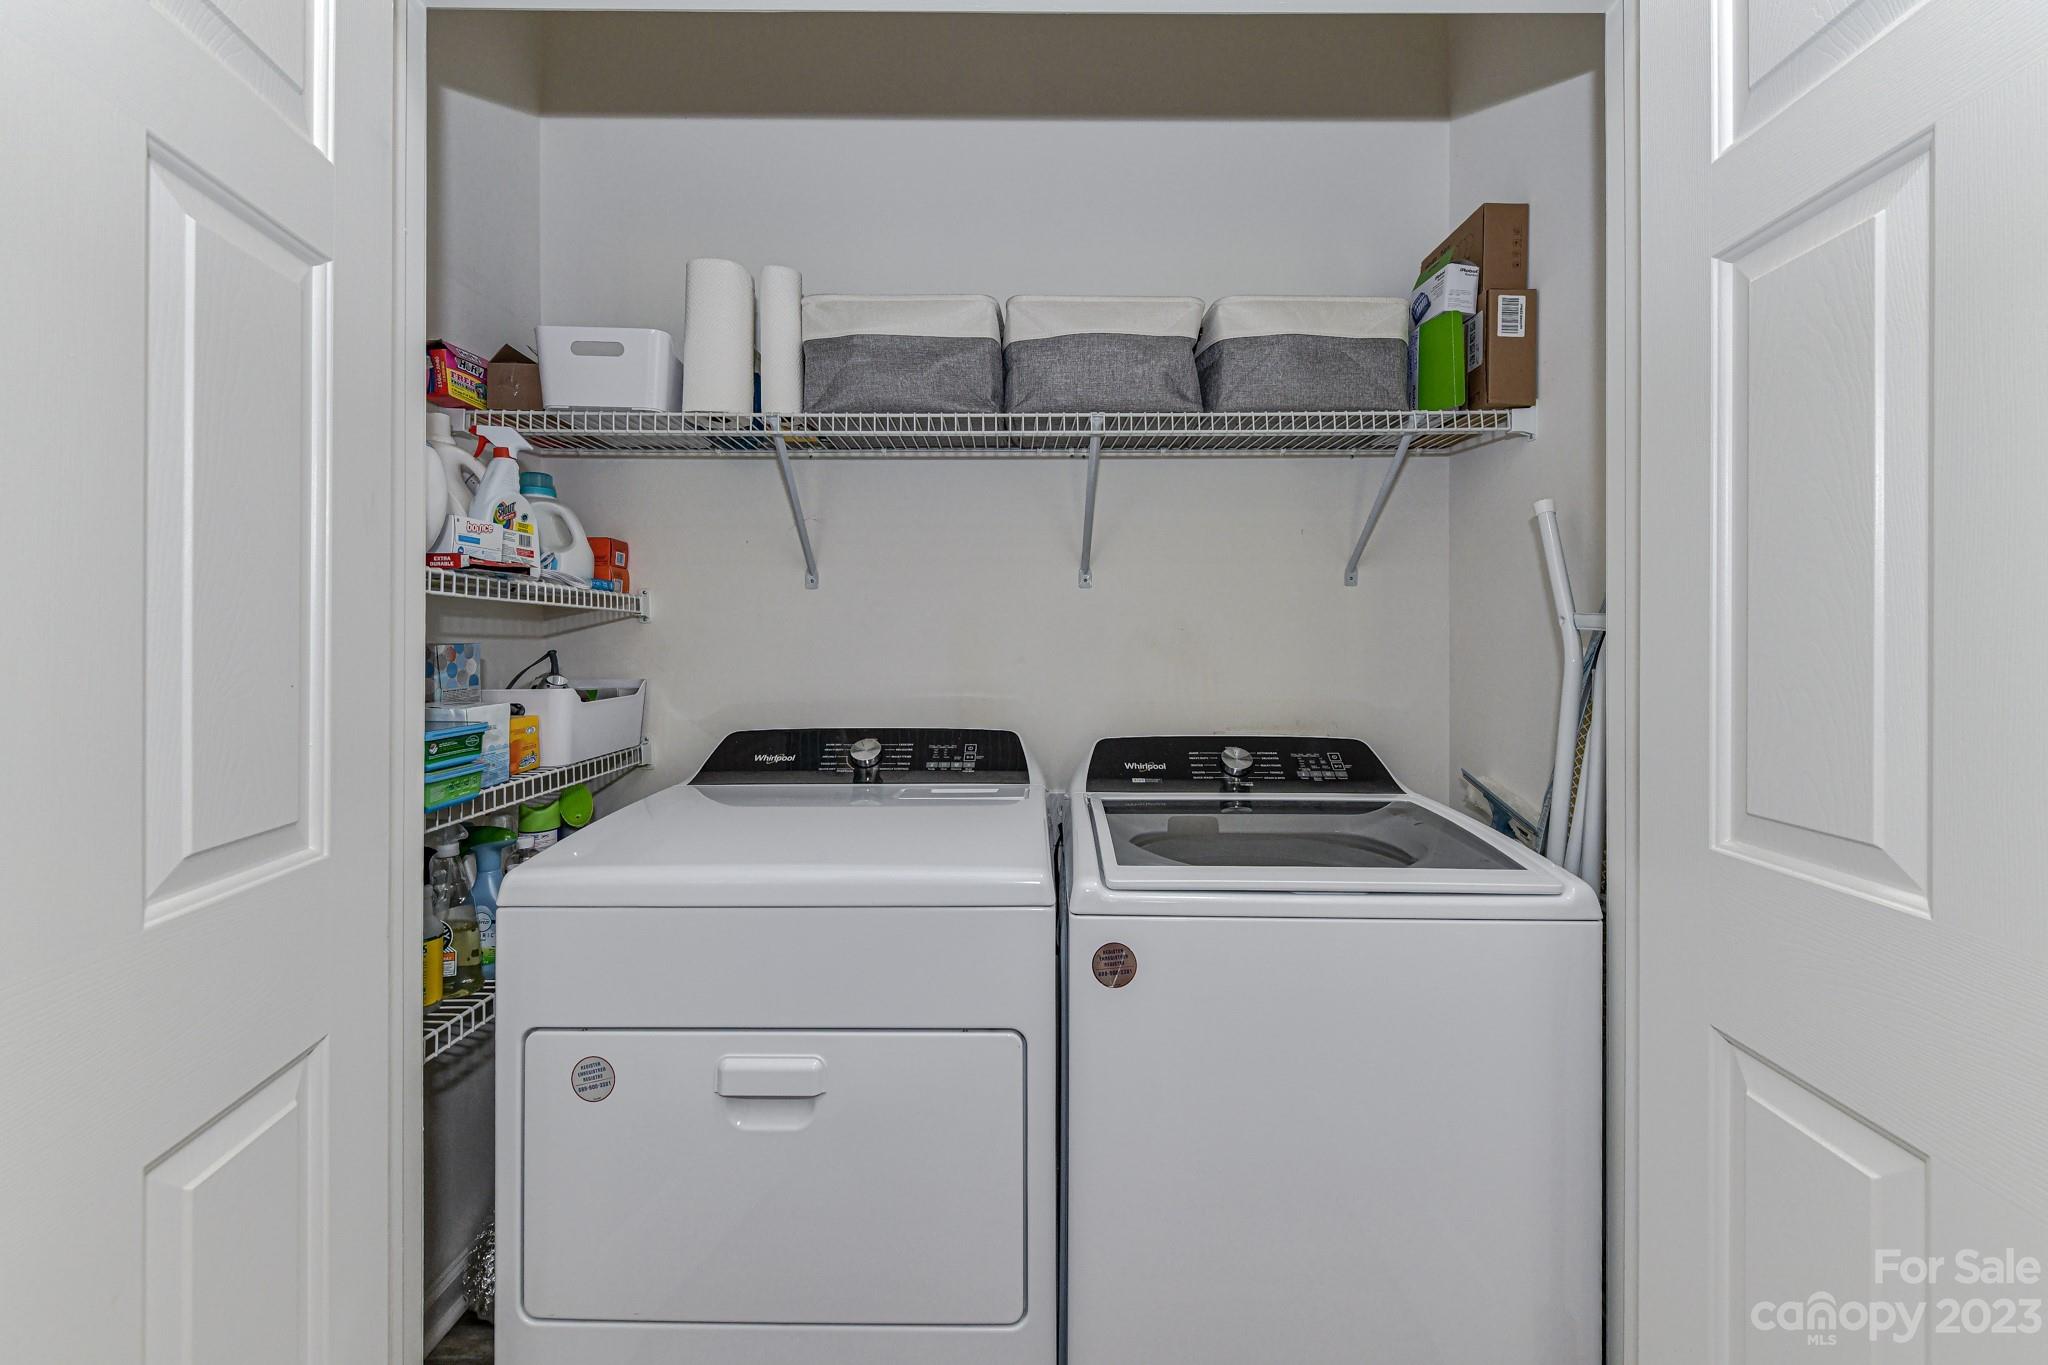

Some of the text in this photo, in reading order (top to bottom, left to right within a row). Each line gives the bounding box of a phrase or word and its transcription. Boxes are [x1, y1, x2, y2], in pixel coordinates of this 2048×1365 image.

[466, 521, 494, 535] bounce
[754, 753, 797, 764] Whirlpool
[1124, 761, 1167, 772] Whirlpool
